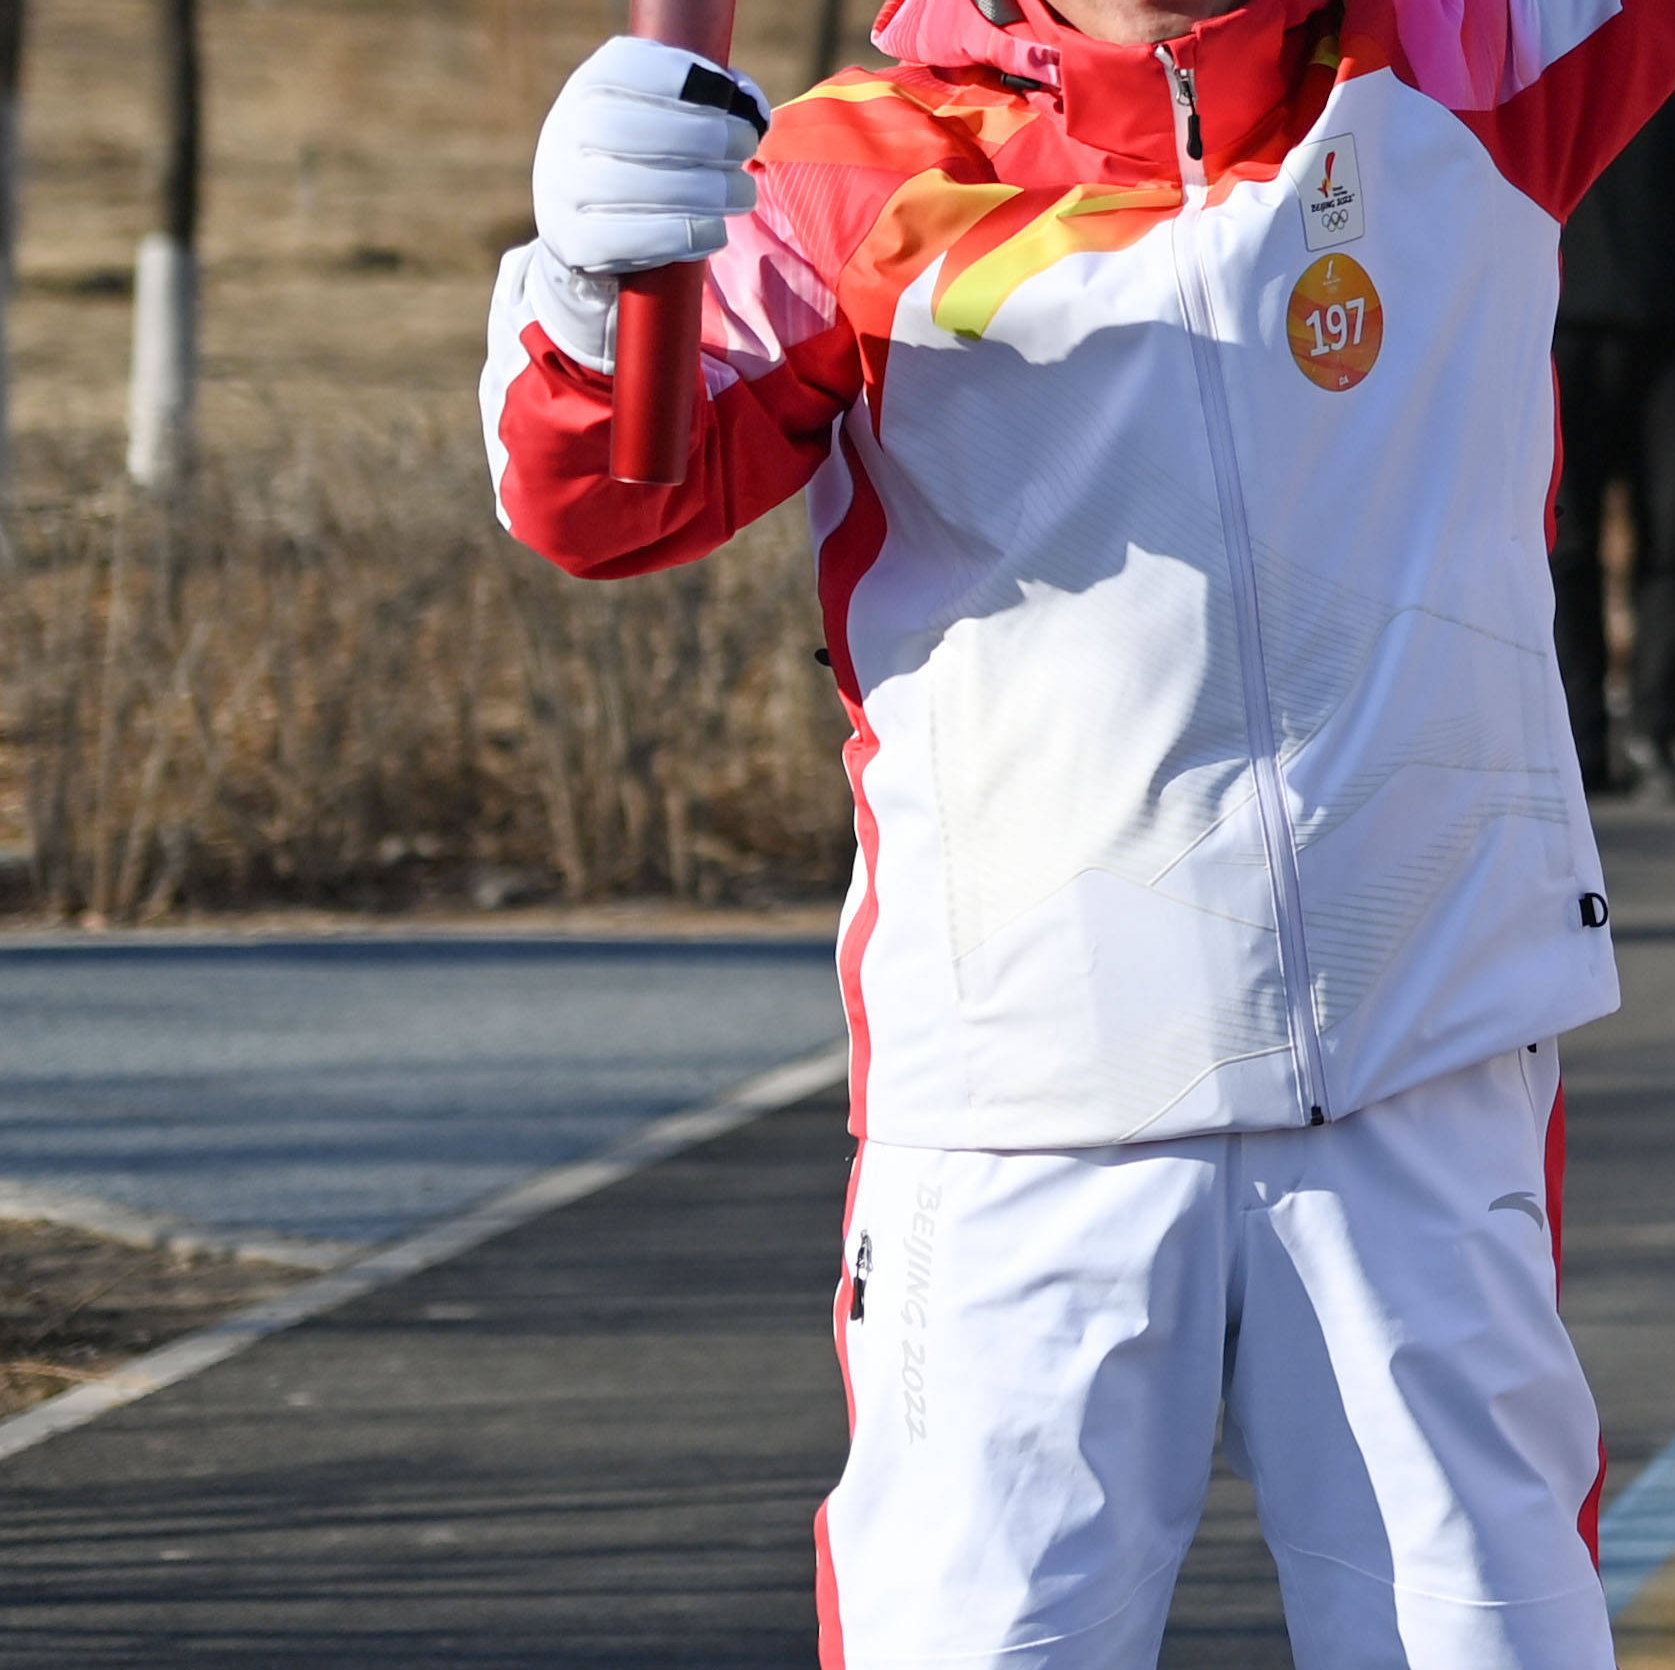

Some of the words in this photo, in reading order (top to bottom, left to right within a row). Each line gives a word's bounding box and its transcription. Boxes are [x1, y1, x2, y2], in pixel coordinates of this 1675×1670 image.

[1305, 297, 1366, 358] 197
[900, 1183, 943, 1329] BEIJING
[900, 1341, 927, 1446] 2022
